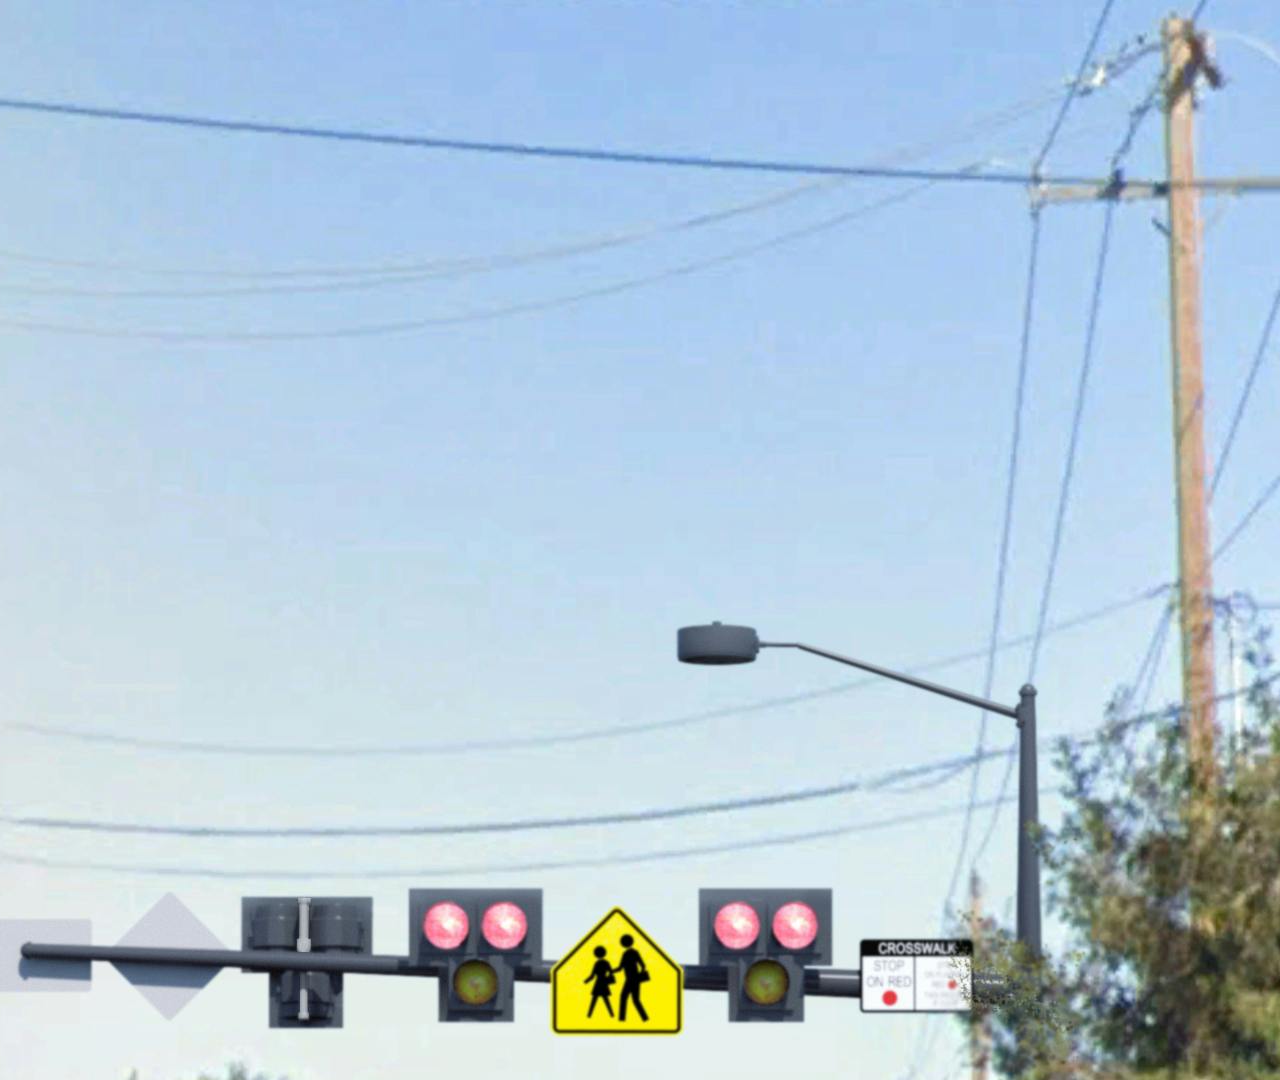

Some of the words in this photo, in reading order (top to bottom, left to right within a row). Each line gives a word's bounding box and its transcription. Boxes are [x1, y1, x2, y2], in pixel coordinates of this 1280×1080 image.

[878, 942, 956, 954] CROSSWALK
[873, 960, 905, 972] STOP
[866, 976, 883, 988] ON
[888, 976, 912, 988] RED
